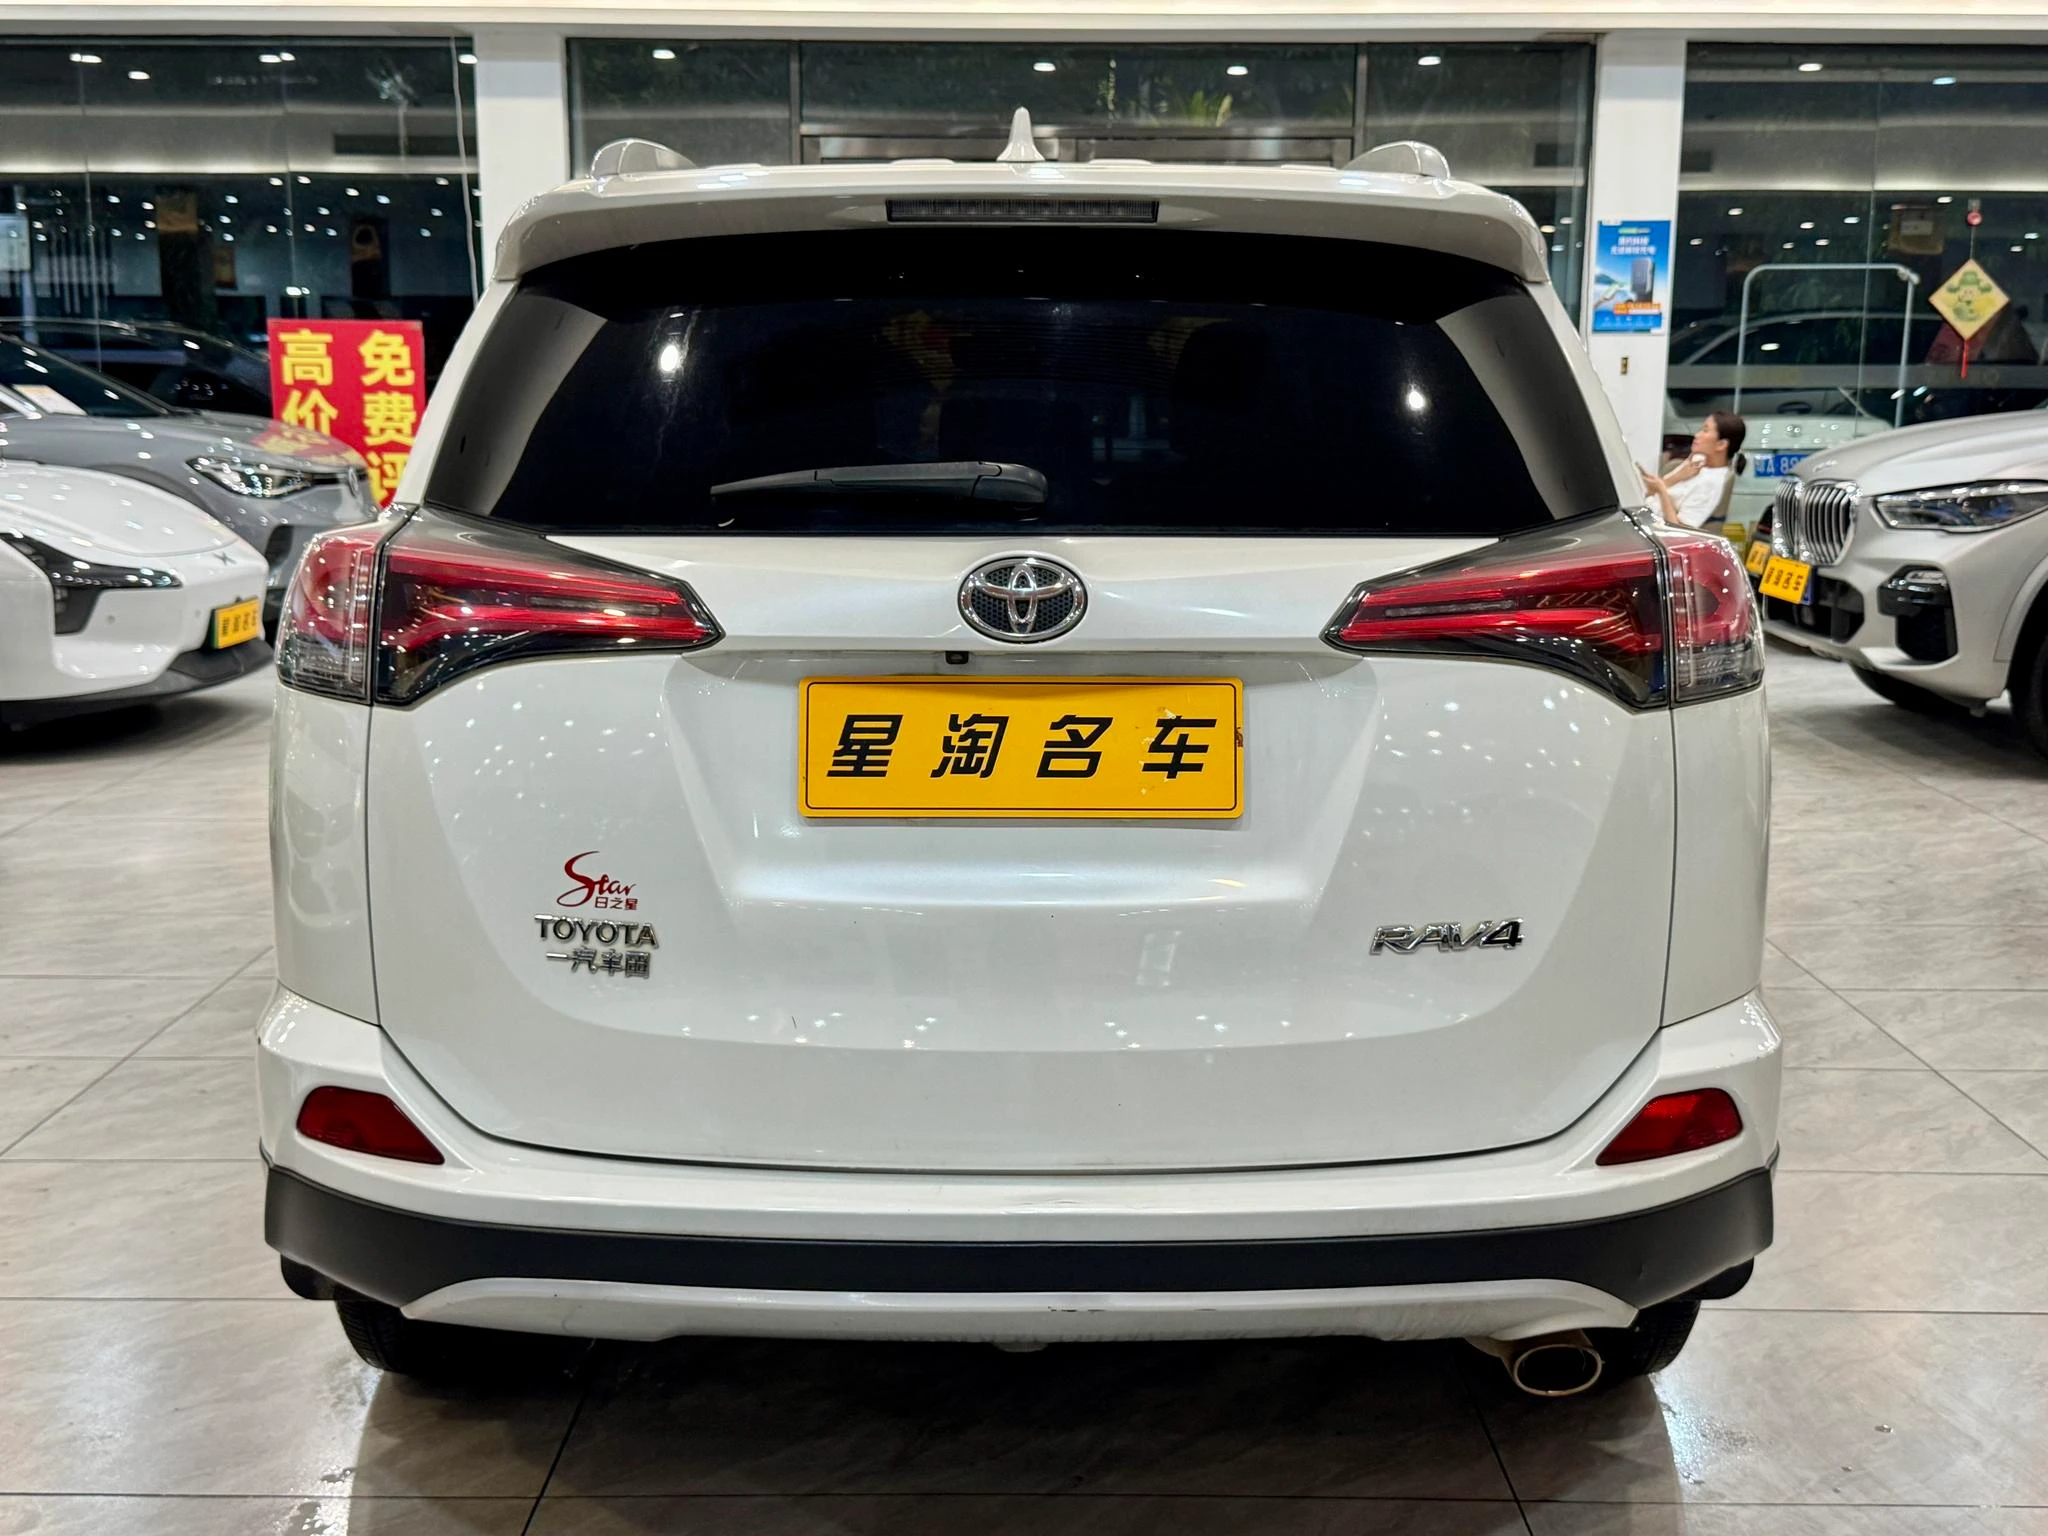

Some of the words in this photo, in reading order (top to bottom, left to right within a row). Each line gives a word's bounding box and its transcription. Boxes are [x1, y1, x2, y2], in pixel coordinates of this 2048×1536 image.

[278, 328, 339, 436] 高价
[826, 713, 1217, 779] 星淘名车
[556, 850, 636, 907] Star
[594, 896, 638, 910] 日之星
[534, 913, 659, 949] TOYOTA
[1369, 917, 1525, 955] RAV4
